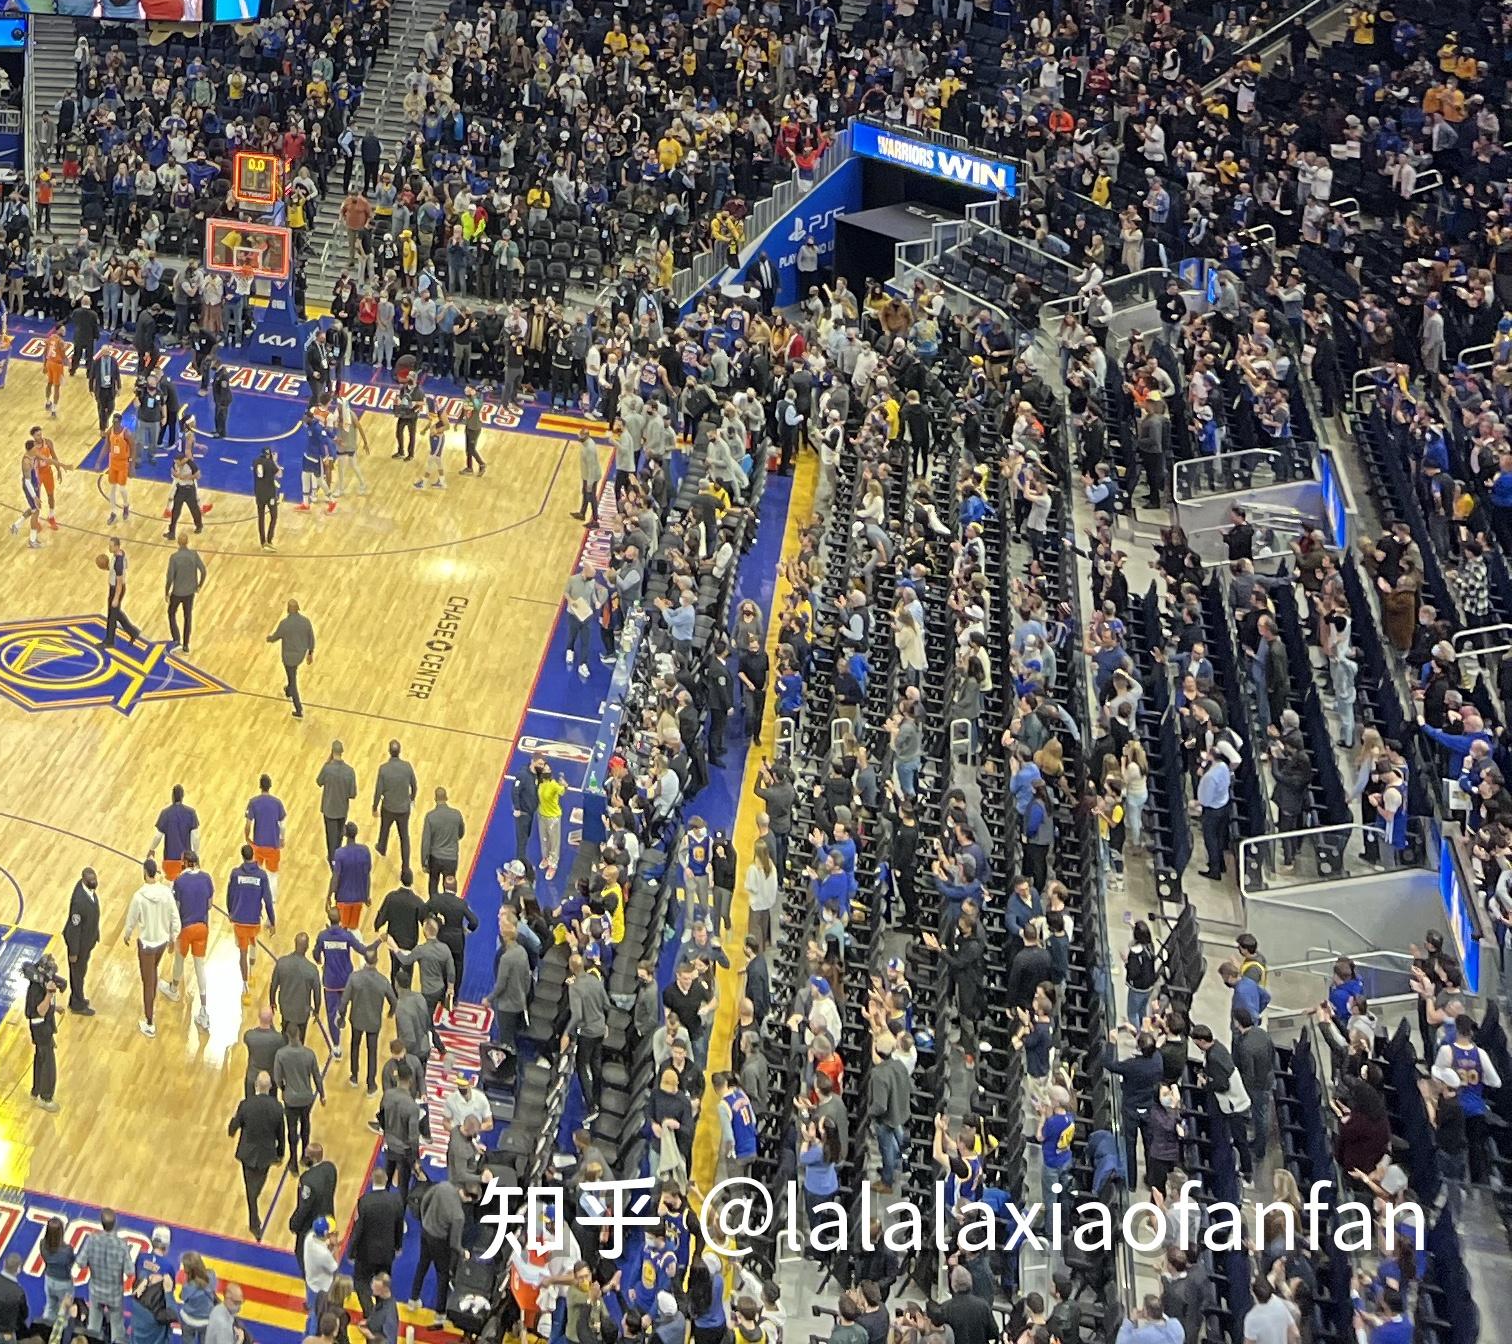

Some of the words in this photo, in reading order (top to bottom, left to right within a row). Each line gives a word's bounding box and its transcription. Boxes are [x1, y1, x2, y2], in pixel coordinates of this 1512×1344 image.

[247, 157, 266, 172] 0.0
[877, 135, 935, 169] WARRIORS
[936, 150, 1006, 188] WIN
[433, 595, 470, 640] CHASE
[406, 653, 446, 700] CENTER
